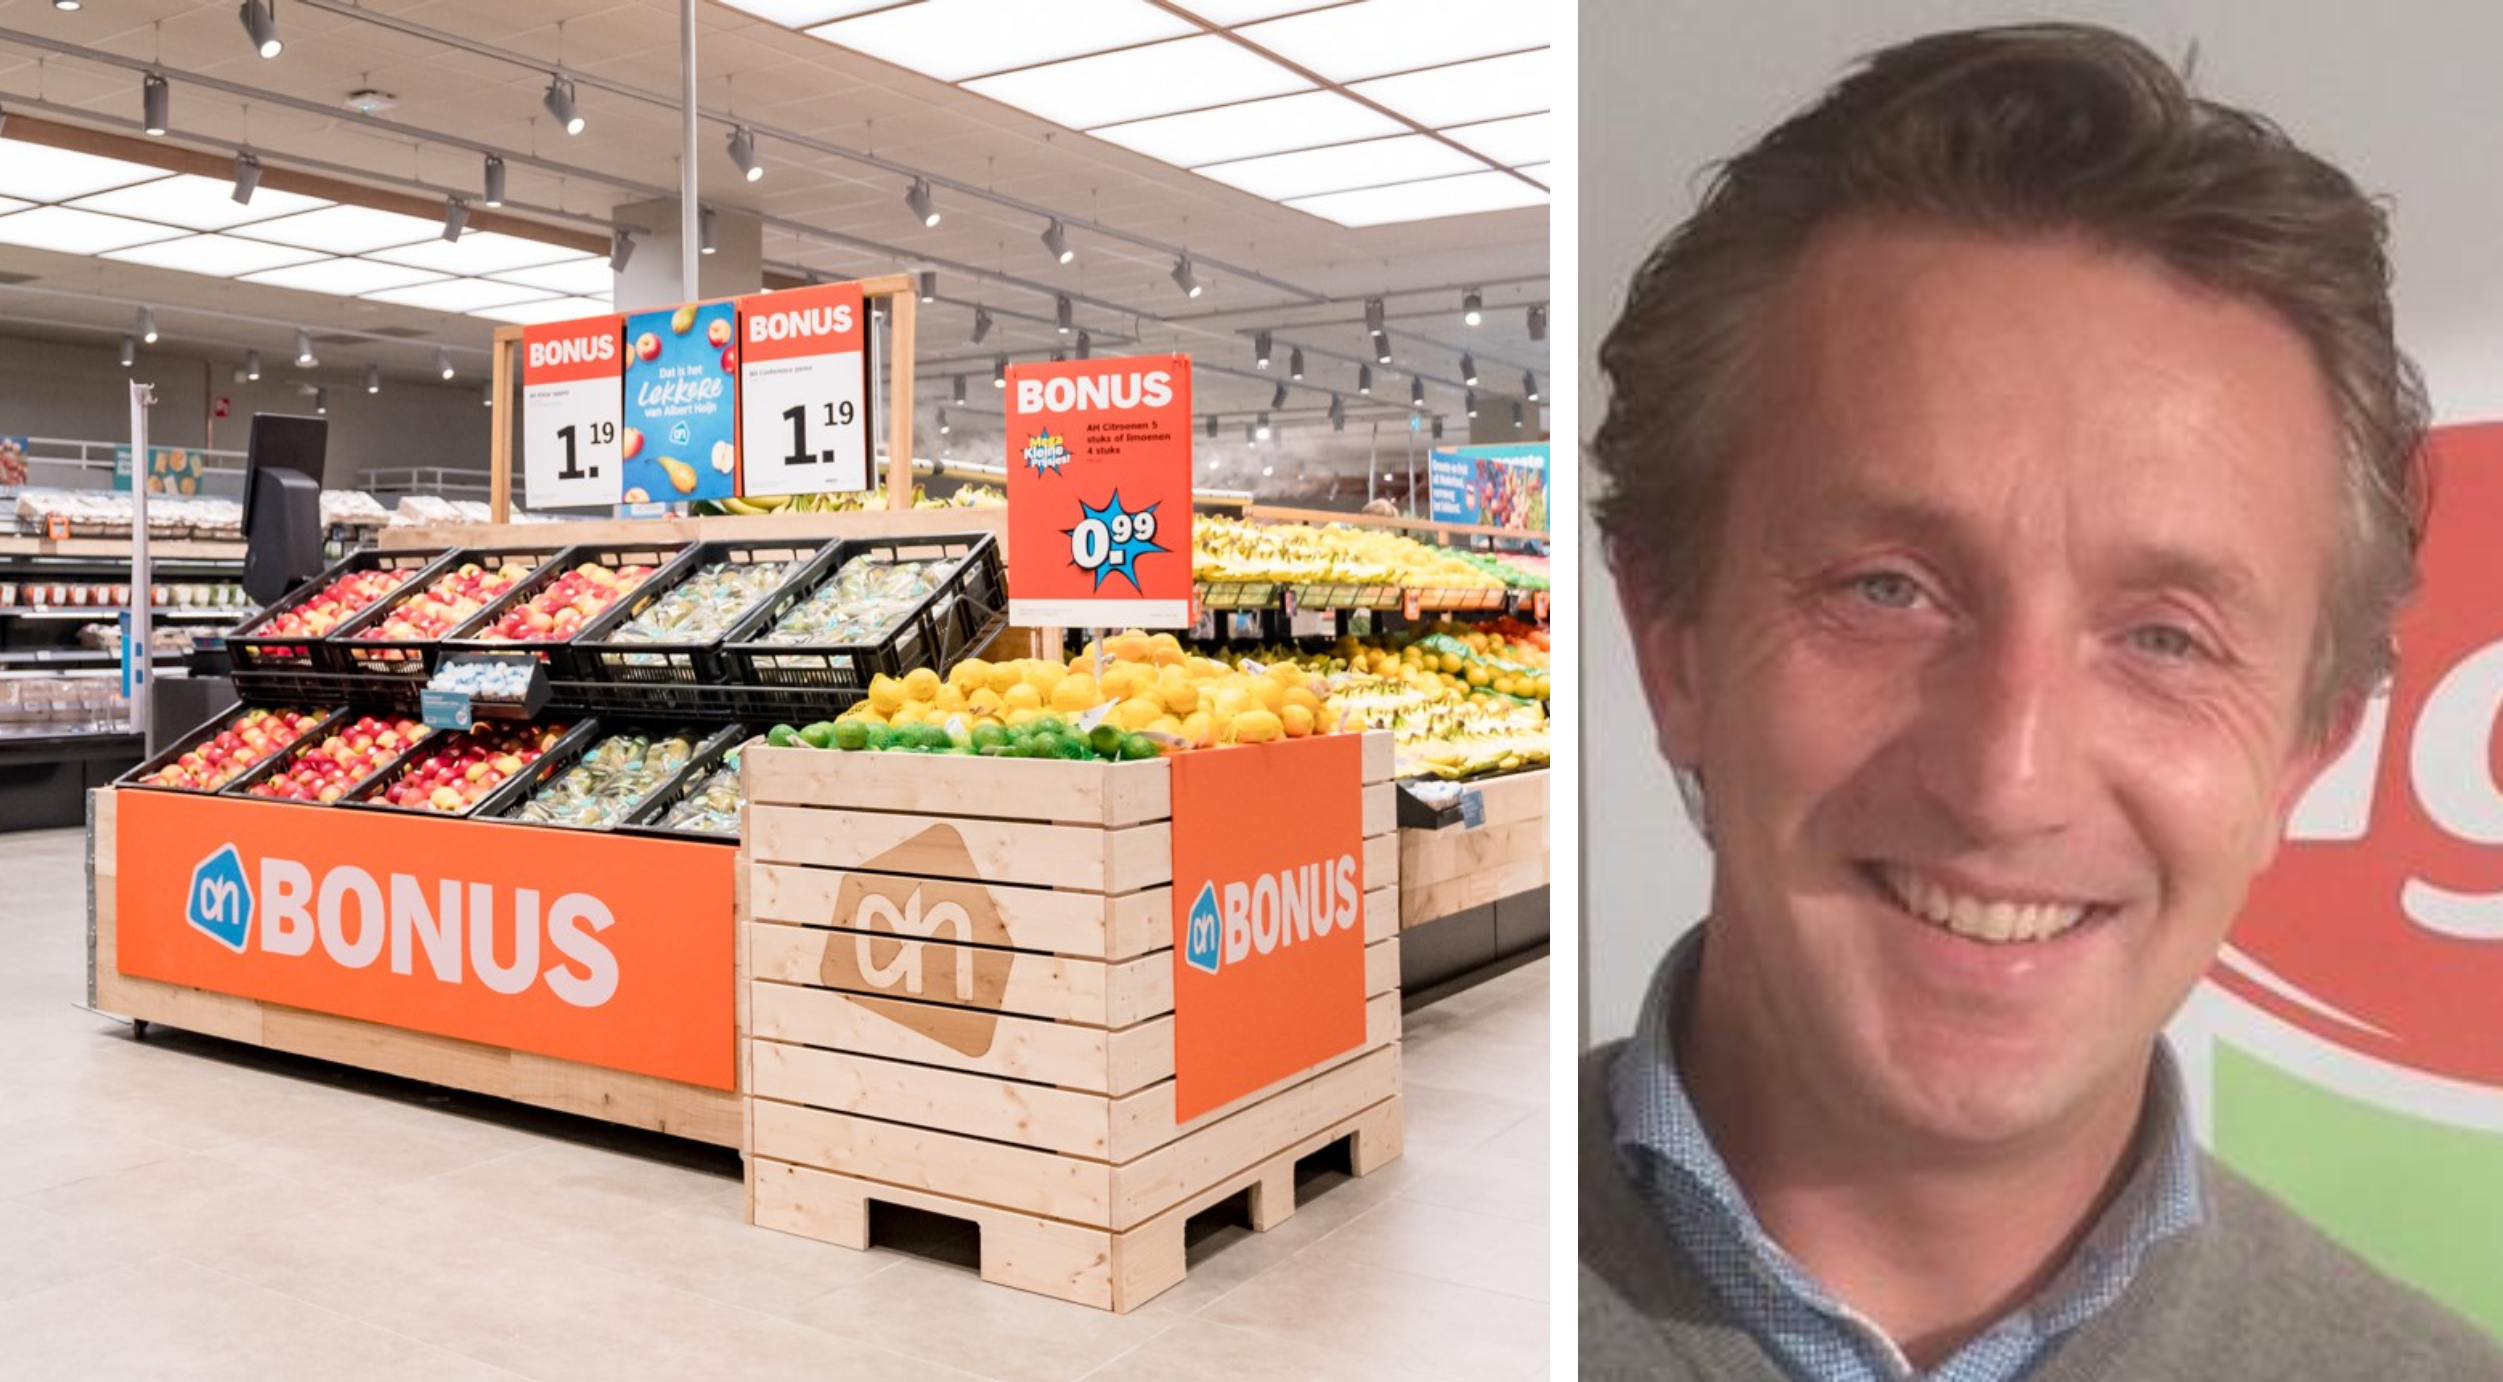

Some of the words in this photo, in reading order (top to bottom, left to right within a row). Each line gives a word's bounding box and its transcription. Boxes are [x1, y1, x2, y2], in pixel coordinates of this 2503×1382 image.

[749, 304, 853, 344] BONUS
[529, 334, 615, 369] BONUS
[659, 367, 676, 379] Dat
[677, 366, 685, 377] is
[687, 365, 703, 376] het
[1017, 371, 1173, 414] BONUS
[644, 408, 662, 418] van
[664, 405, 693, 416] Albert
[694, 402, 717, 416] Heijn
[1087, 423, 1100, 432] AH
[1103, 422, 1148, 431] Citroenen
[1152, 421, 1158, 429] 5
[1087, 435, 1111, 443] stuks
[1114, 434, 1124, 442] of
[1126, 433, 1171, 442] limoenen
[1087, 446, 1093, 454] 4
[1095, 446, 1121, 454] stuks
[1224, 854, 1358, 965] BONUS
[260, 856, 620, 1008] BONUS
